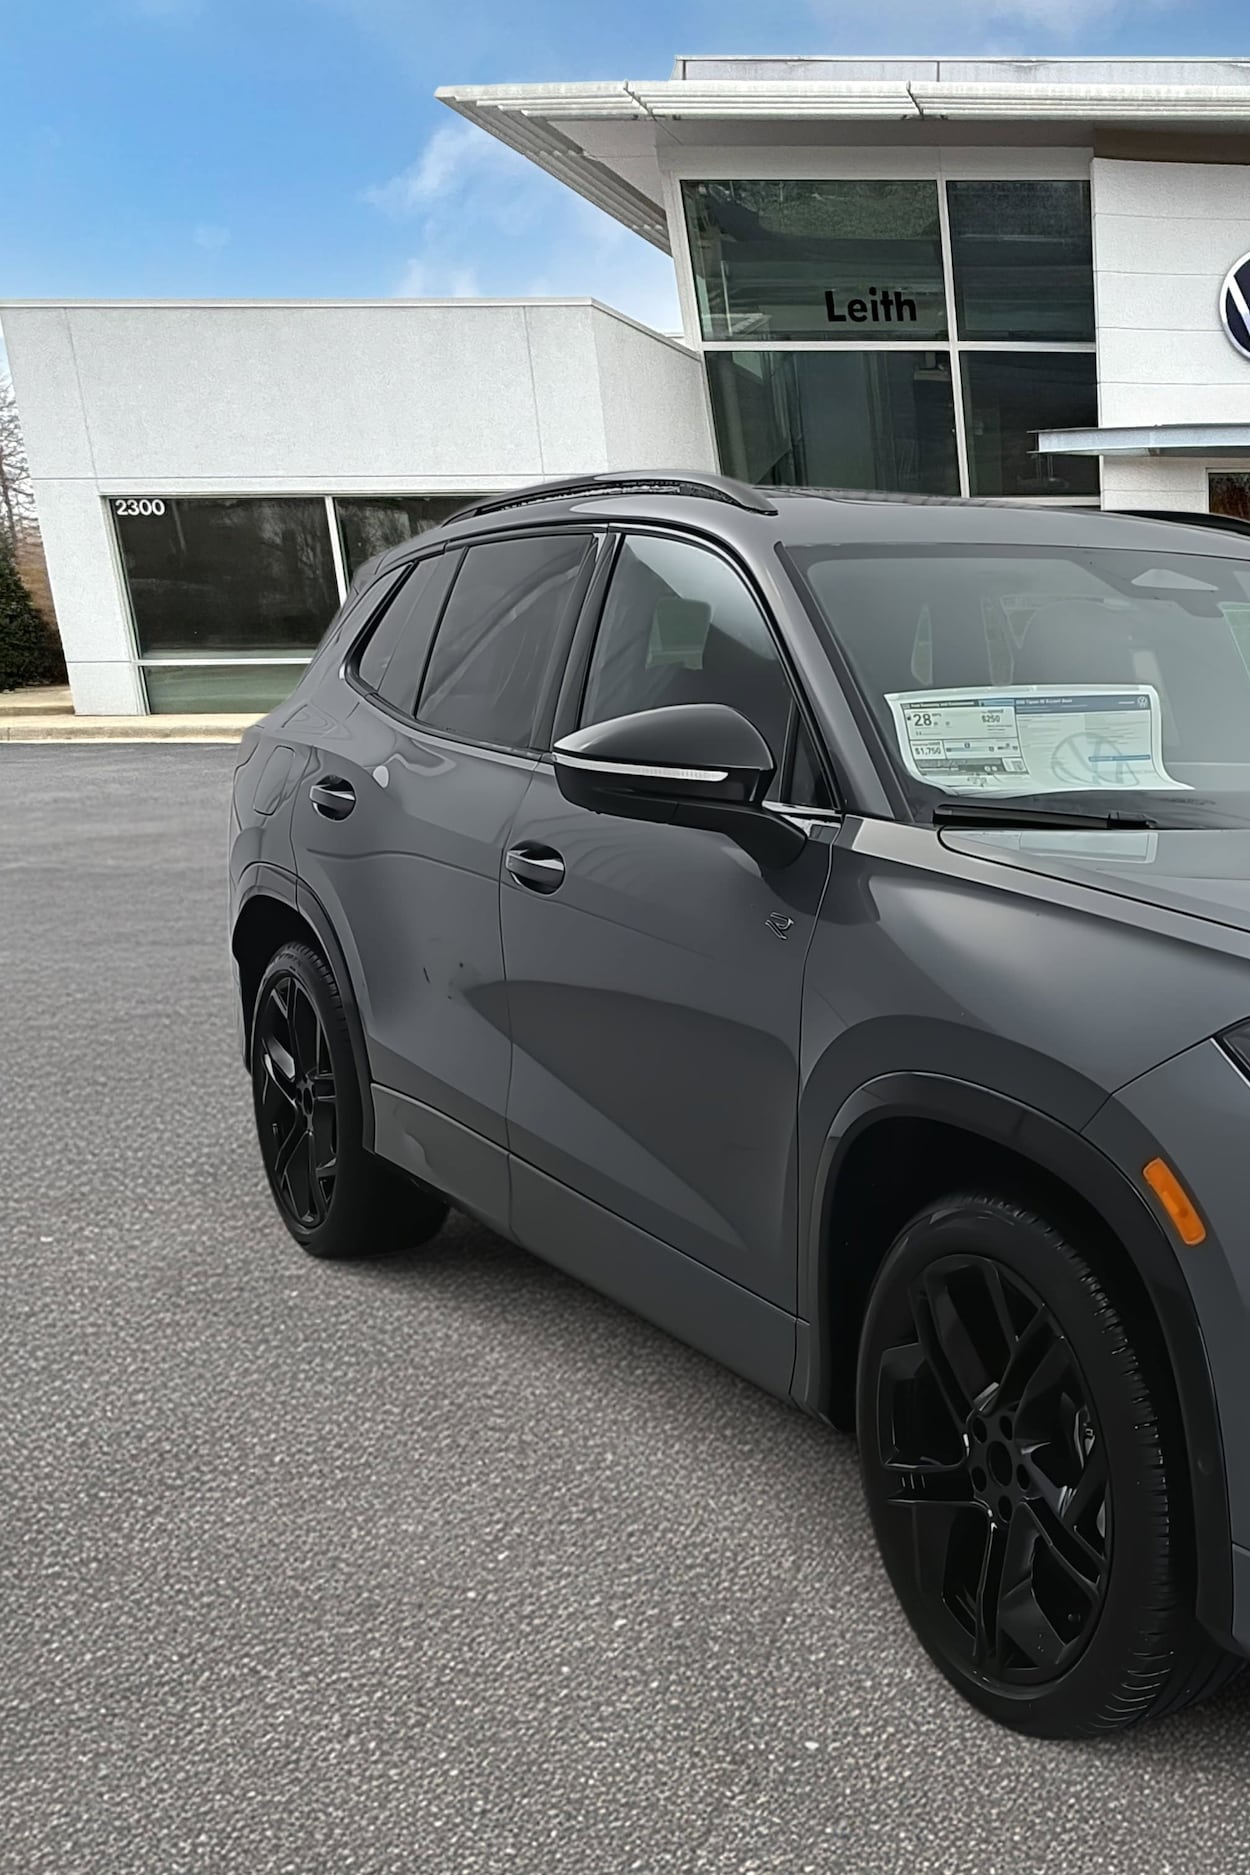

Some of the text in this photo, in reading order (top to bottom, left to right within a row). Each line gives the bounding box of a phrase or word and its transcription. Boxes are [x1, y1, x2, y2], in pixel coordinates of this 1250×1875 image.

[825, 286, 917, 322] Leith
[115, 499, 165, 516] 2300
[913, 713, 932, 727] 28
